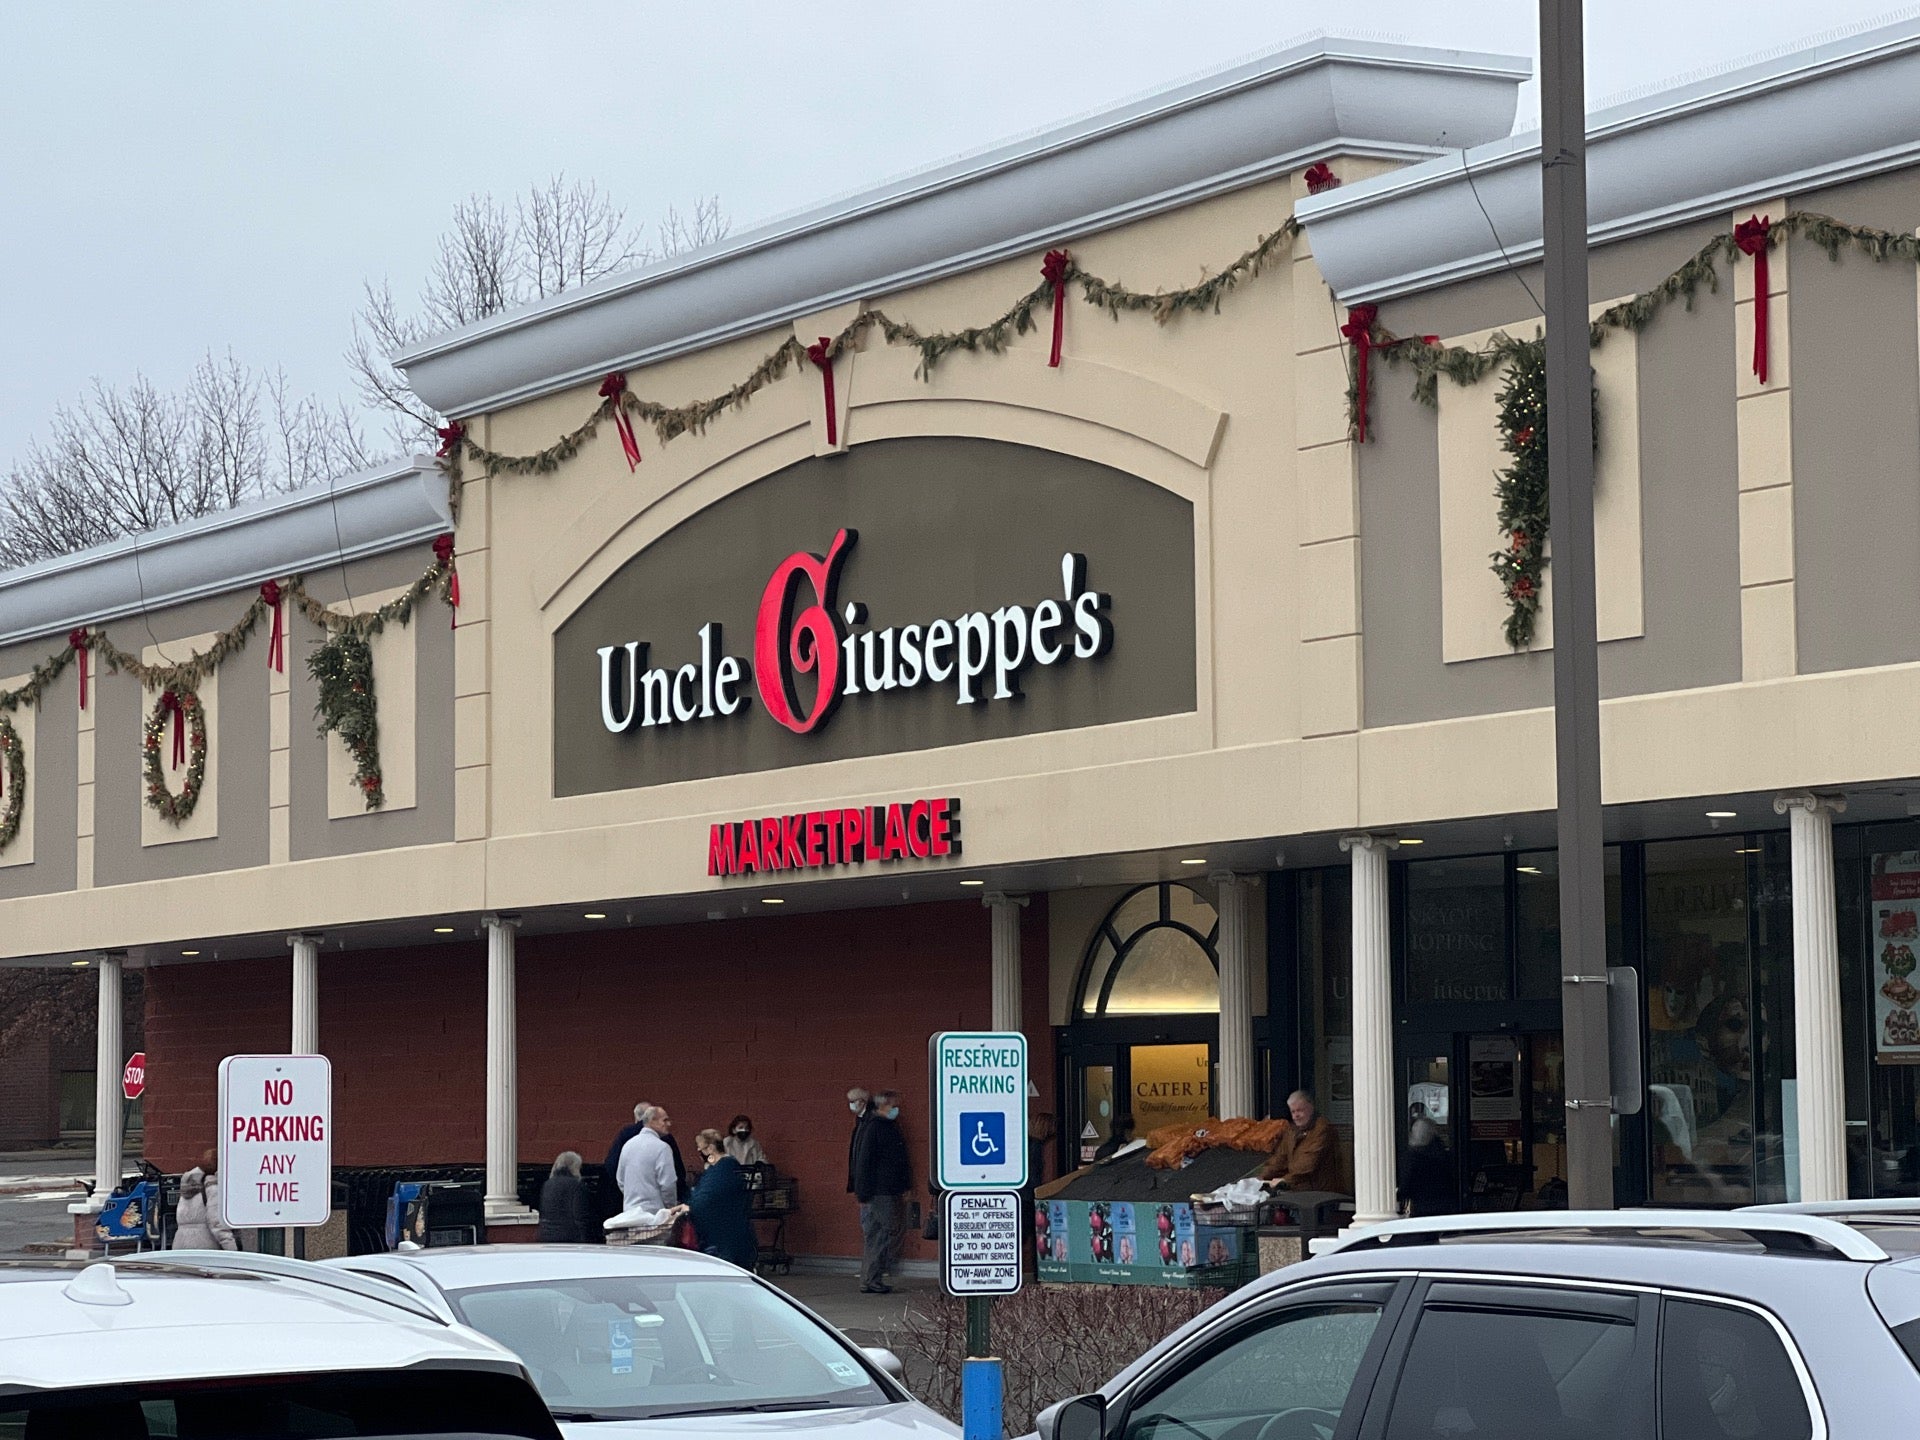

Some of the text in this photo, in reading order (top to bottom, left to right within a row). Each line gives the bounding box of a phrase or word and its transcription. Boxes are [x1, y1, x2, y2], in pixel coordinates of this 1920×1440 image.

[597, 528, 1108, 733] Uncle Giuseppe's
[708, 798, 957, 876] MARKETPLACE
[944, 1049, 1020, 1068] RESERVED
[264, 1079, 293, 1106] NO
[949, 1075, 1015, 1094] PARKING
[1136, 1081, 1193, 1097] CATER
[232, 1115, 324, 1142] PARKING
[259, 1154, 296, 1175] ANY
[256, 1182, 299, 1203] TIME
[961, 1198, 1006, 1208] PENALTY
[983, 1211, 1015, 1219] OFFENSE
[953, 1221, 1015, 1230] SUBSEQUENT OFFENSES
[953, 1242, 1015, 1251] UP TO 90 DAYS
[953, 1252, 1015, 1261] COMMUNITY SERVICE
[953, 1267, 1015, 1278] TOW-AWAY ZONE
